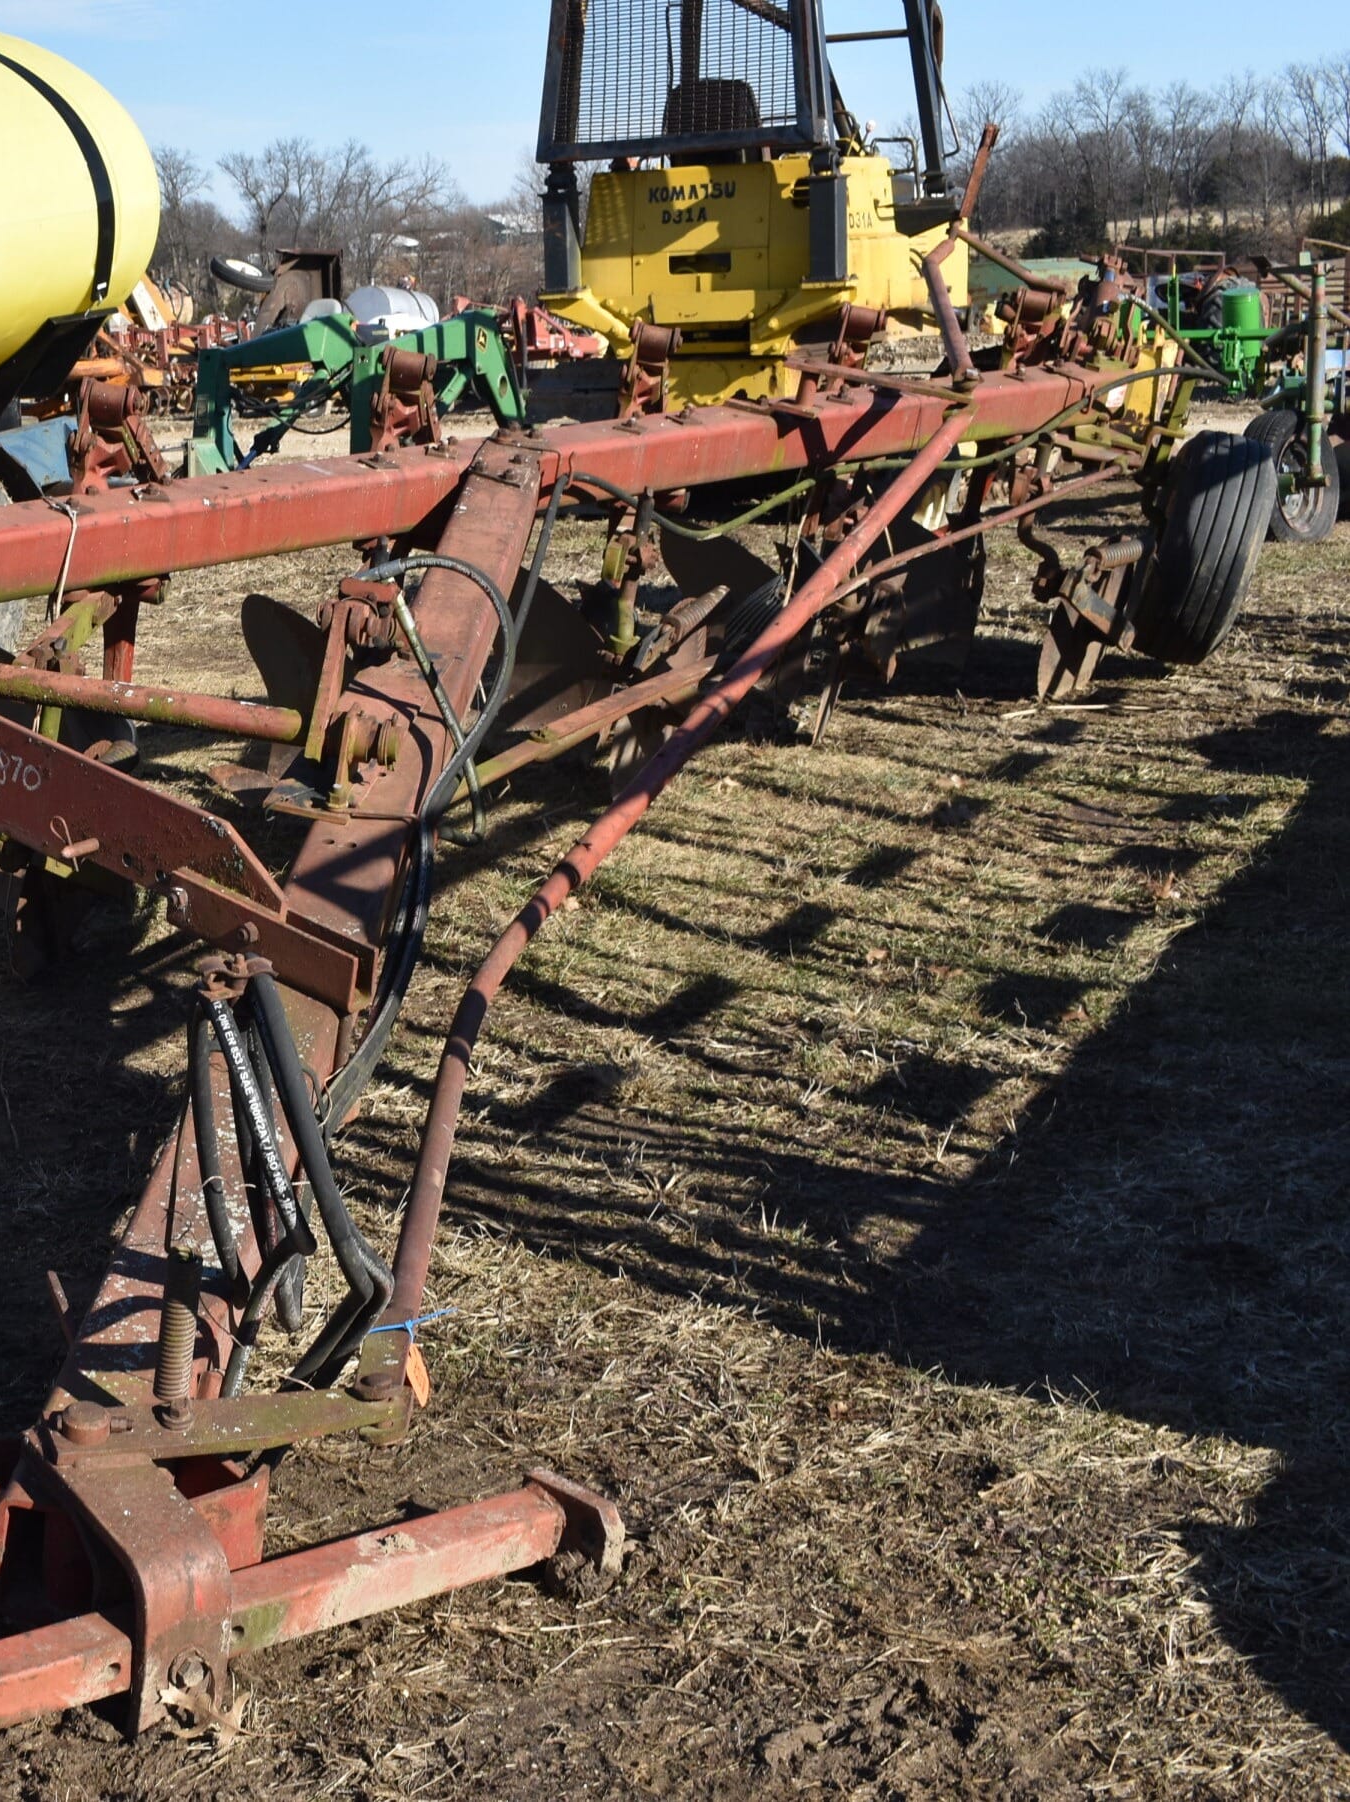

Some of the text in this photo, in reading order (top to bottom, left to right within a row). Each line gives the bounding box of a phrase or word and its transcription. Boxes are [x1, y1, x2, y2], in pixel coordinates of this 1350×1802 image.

[649, 182, 736, 203] KOMATSU
[662, 207, 708, 225] D31A
[849, 211, 873, 229] D31A
[224, 1031, 236, 1045] EN
[240, 1071, 254, 1096] SAE
[248, 1096, 271, 1144] 100R2AT
[265, 1151, 278, 1170] ISO
